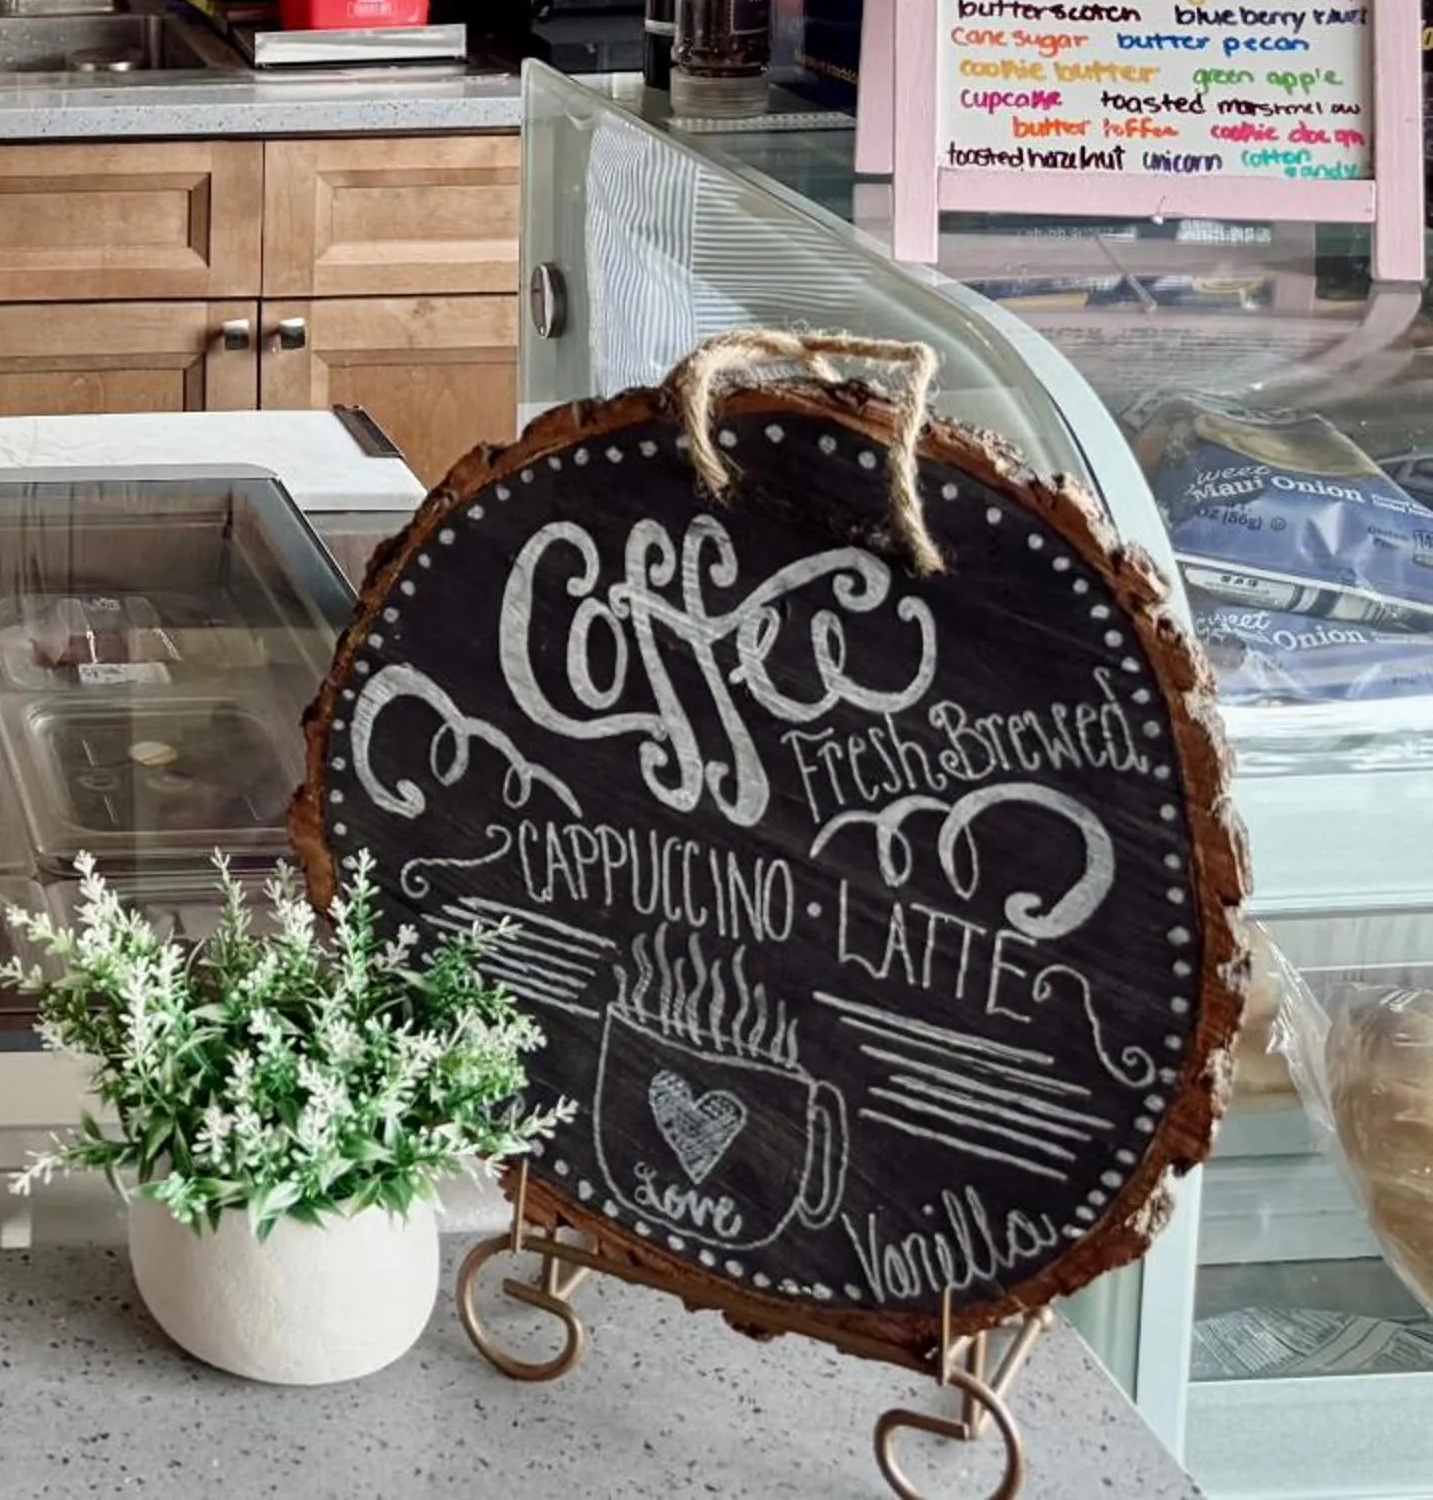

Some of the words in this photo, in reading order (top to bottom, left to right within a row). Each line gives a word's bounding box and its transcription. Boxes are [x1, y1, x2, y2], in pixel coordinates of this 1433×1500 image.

[1117, 32, 1210, 51] butter
[1223, 37, 1310, 57] pecan
[960, 59, 1046, 80] cookie
[1053, 61, 1160, 83] butter
[1193, 68, 1255, 95] green
[1101, 91, 1207, 114] toasted
[1013, 116, 1090, 138] butter
[1210, 122, 1280, 142] cookie
[949, 141, 1024, 172] toasted
[1143, 151, 1223, 172] unicorn
[1191, 476, 1265, 502] Maui
[1271, 476, 1365, 503] Onion
[1273, 626, 1368, 651] Onion
[500, 514, 936, 827] Coffee
[781, 710, 947, 824] Fresh
[517, 821, 795, 942] CAPPUCCINO
[838, 880, 1039, 1023] LATTE
[633, 1164, 745, 1239] Love
[841, 1185, 1056, 1301] Vanilla
